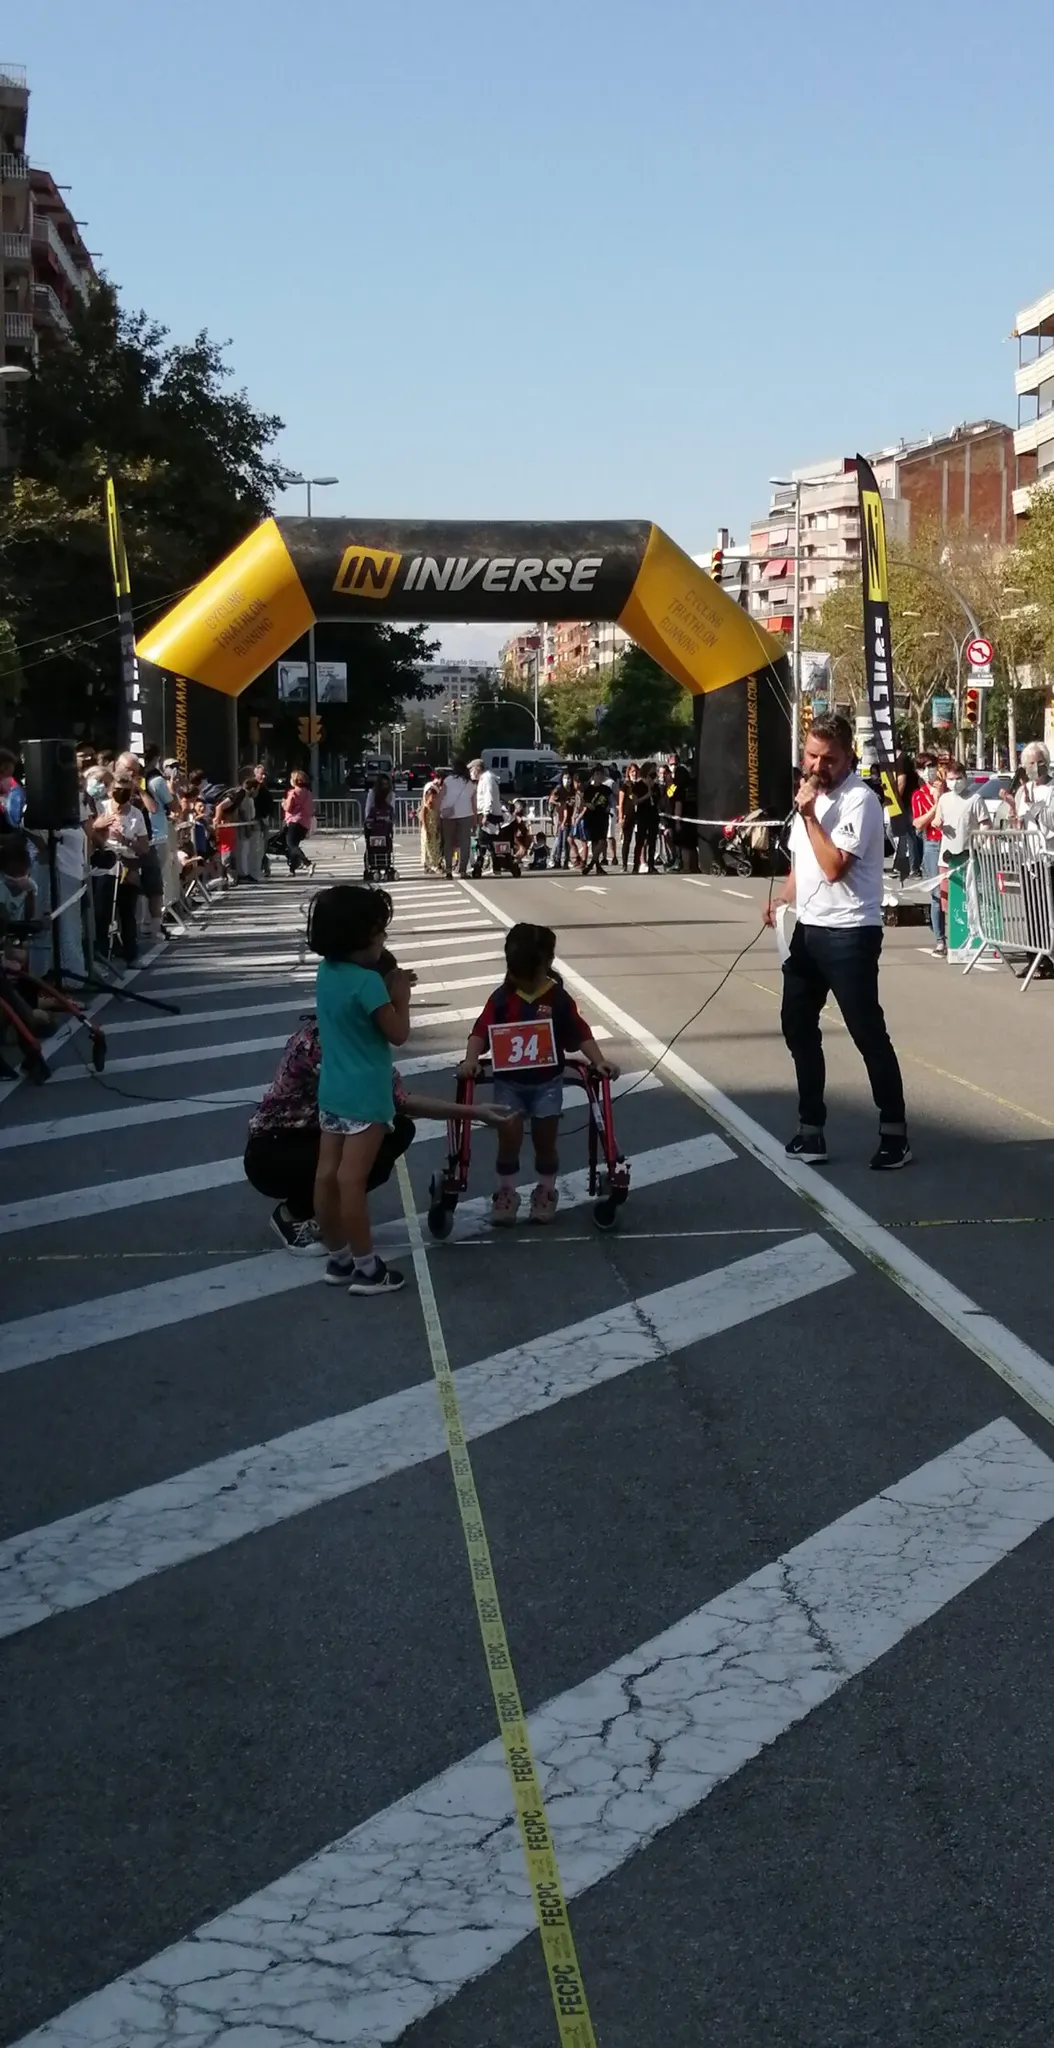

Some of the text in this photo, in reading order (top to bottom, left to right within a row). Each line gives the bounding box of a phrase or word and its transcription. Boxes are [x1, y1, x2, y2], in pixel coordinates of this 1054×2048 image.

[340, 555, 603, 592] IN INVERSE
[205, 590, 245, 630] CYCLING
[213, 597, 268, 649] TRIATHLON
[668, 597, 718, 648] TRIATHLON
[685, 590, 724, 629] CYCLING
[233, 617, 275, 657] RUNNING
[660, 615, 700, 656] RUNNING
[747, 676, 760, 814] WW.INVERSETEAMS.COM
[508, 1034, 539, 1063] 34
[480, 1597, 500, 1623] FECPC
[488, 1642, 508, 1670] FECPC
[498, 1691, 521, 1723] FECPC
[509, 1747, 535, 1783] FECPC
[522, 1809, 550, 1851] FECPC
[536, 1882, 566, 1927] FECPC
[552, 1963, 585, 2016] FECPC
